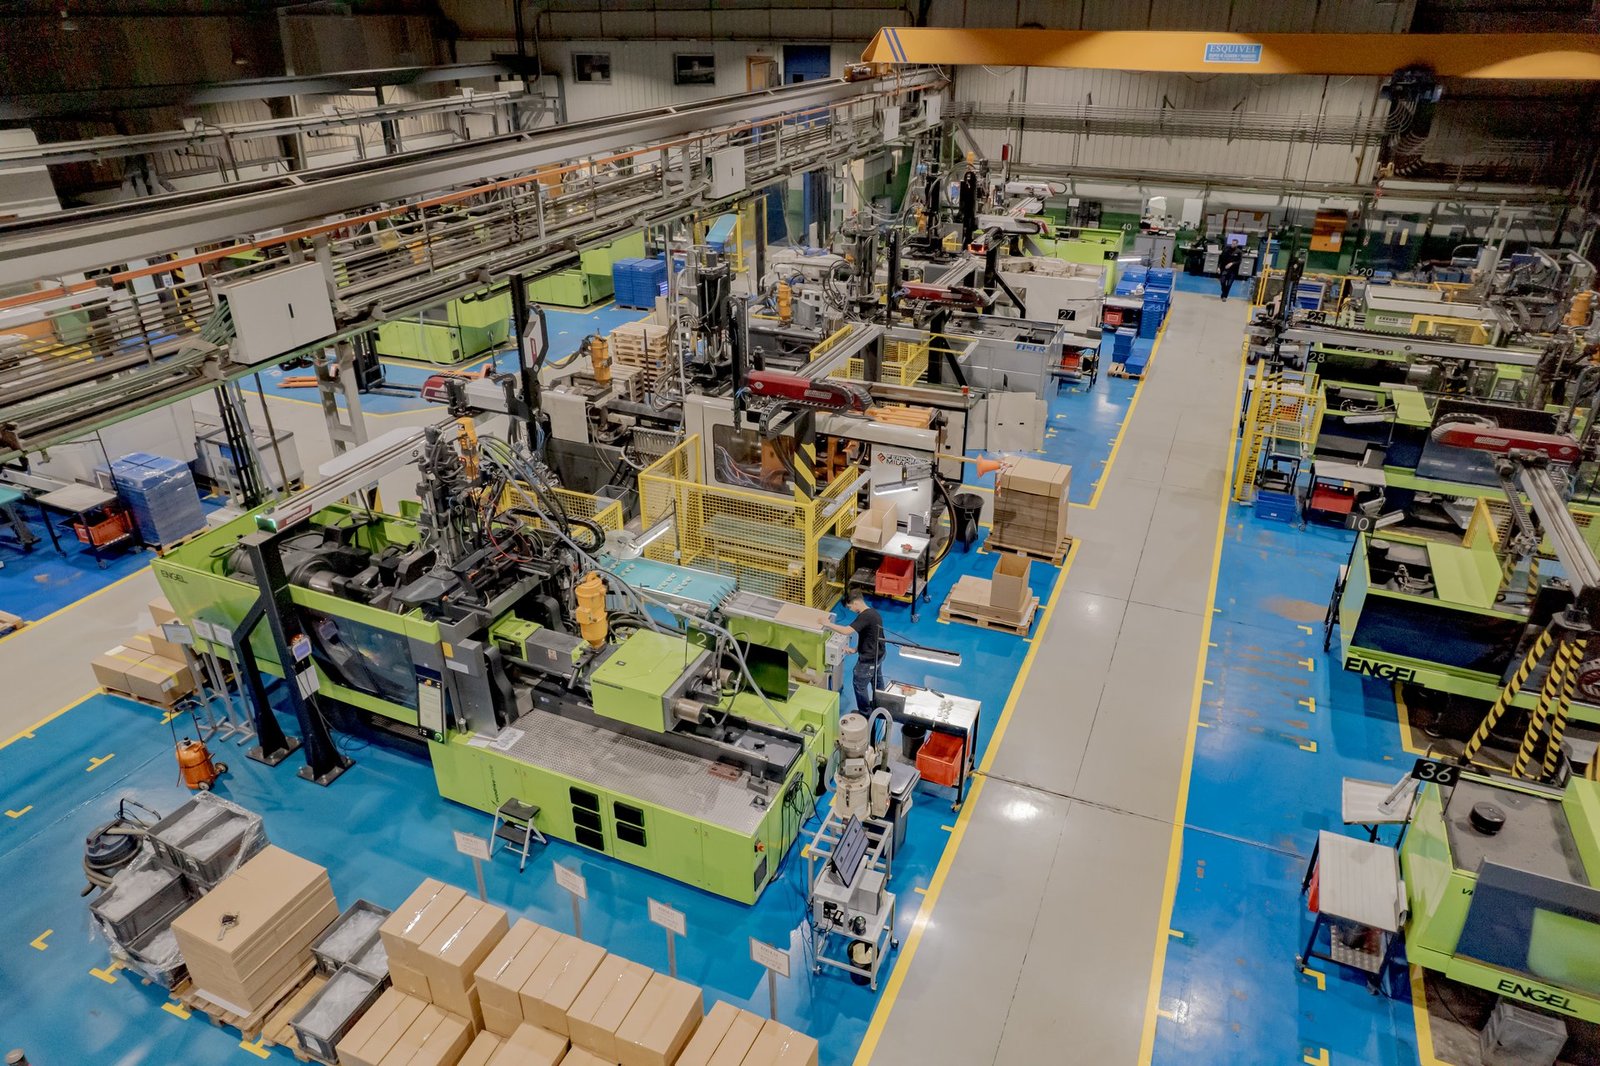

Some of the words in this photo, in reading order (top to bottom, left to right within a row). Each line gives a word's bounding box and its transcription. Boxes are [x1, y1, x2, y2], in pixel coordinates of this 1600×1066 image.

[1209, 45, 1257, 54] ESQUIVEL
[1122, 223, 1132, 231] 40
[1108, 252, 1115, 260] 9
[1360, 267, 1373, 277] 20
[1060, 310, 1073, 320] 27
[1309, 312, 1324, 321] 25
[1309, 352, 1325, 363] 28
[1351, 515, 1370, 531] 10
[696, 632, 707, 648] 2
[1344, 656, 1425, 687] ENGEL
[1419, 762, 1453, 782] 36
[1497, 979, 1578, 1013] ENGEL
